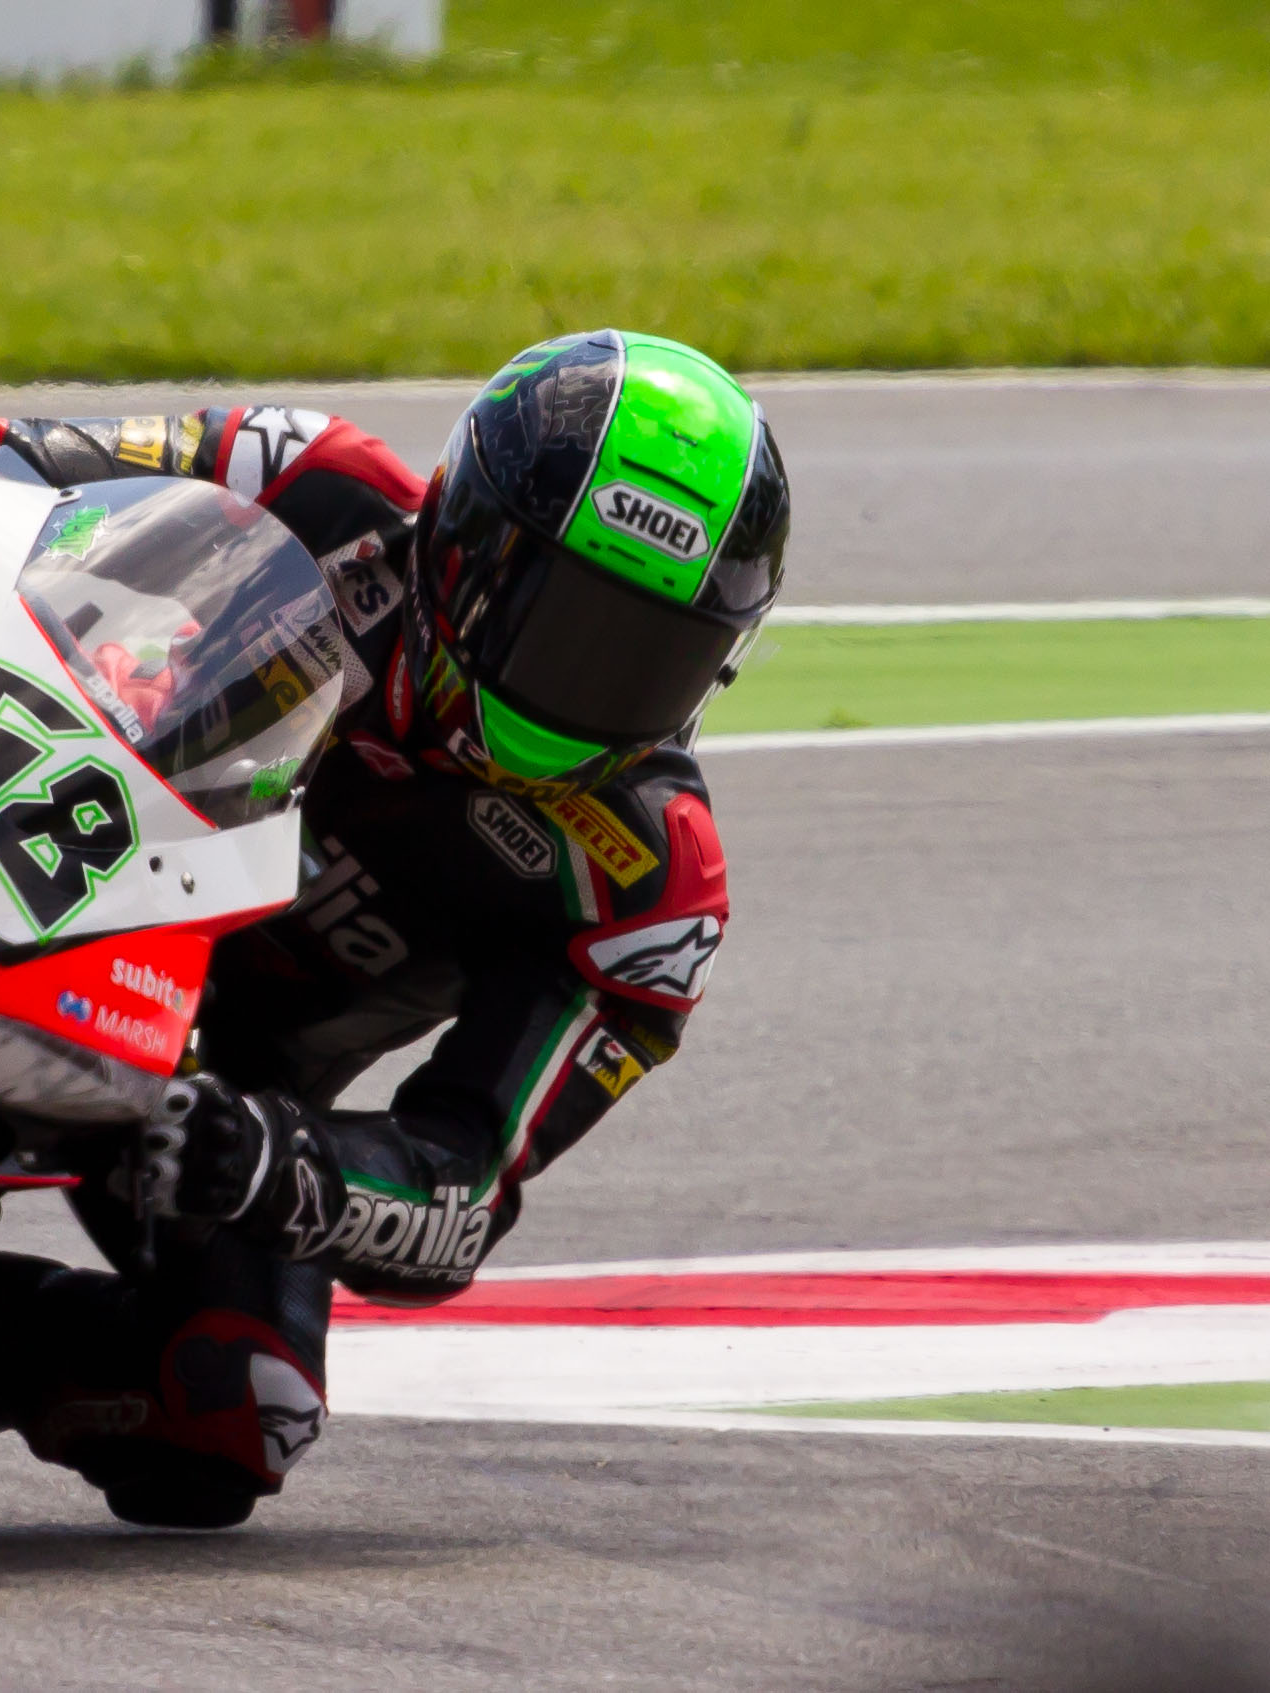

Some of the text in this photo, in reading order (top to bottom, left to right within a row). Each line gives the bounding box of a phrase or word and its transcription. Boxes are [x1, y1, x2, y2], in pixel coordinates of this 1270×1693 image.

[606, 488, 699, 555] SHOEI
[476, 800, 550, 870] SHOEI
[554, 803, 631, 873] RELLI
[93, 1004, 168, 1054] MARSH
[330, 1185, 492, 1268] aprilia
